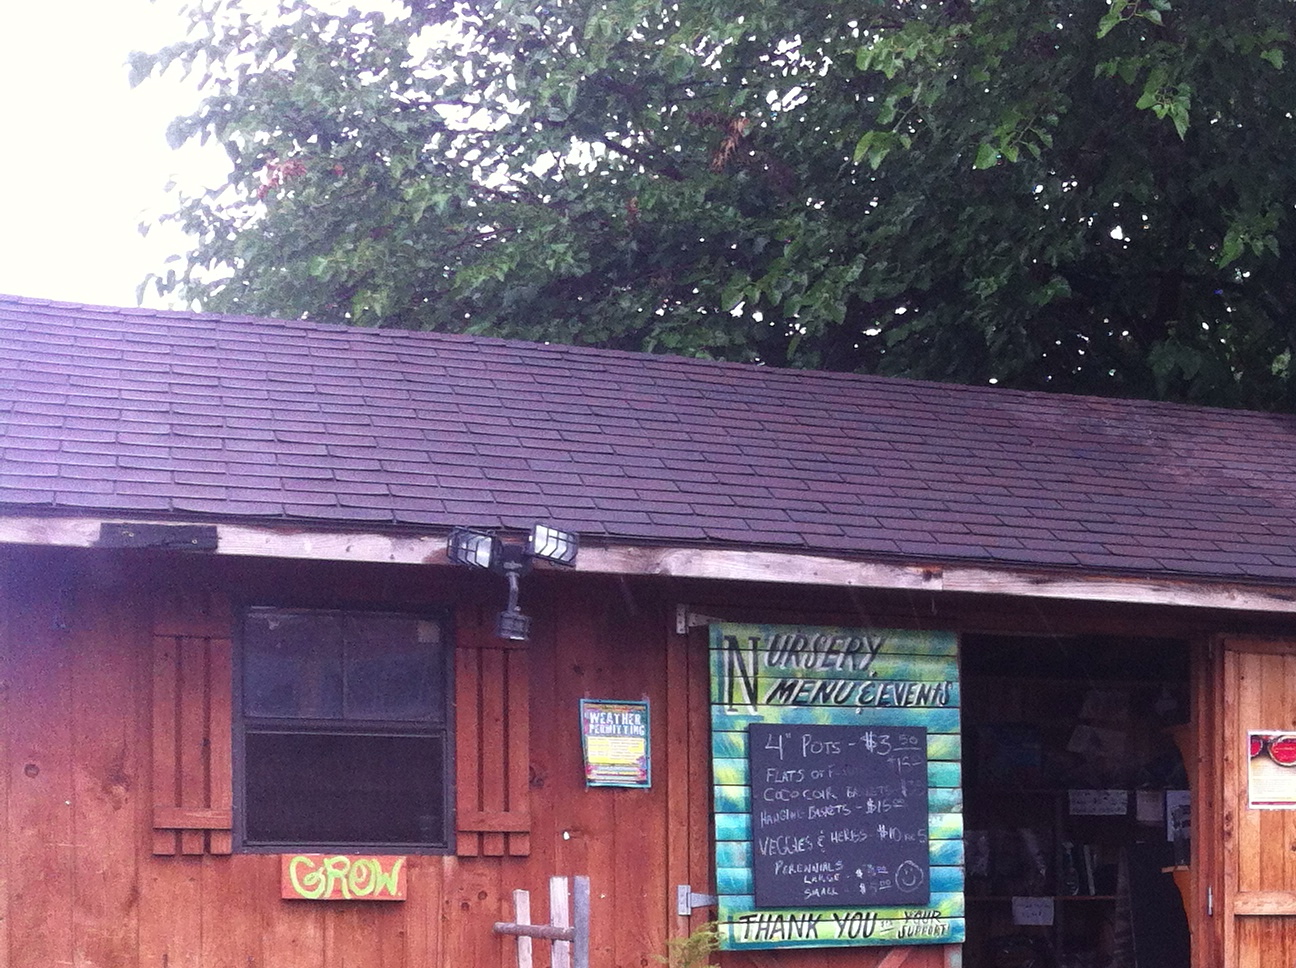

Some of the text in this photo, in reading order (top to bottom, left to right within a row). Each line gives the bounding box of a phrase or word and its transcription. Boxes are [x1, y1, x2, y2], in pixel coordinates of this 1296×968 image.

[723, 632, 884, 716] NURSERY
[764, 679, 854, 705] MENU
[589, 711, 642, 726] WEATHER
[589, 723, 646, 736] PERMITTING
[802, 733, 841, 758] POTS
[766, 767, 806, 783] FLATS
[288, 855, 406, 900] GROW
[774, 860, 843, 876] PERENNIALS
[739, 911, 823, 942] THANK
[831, 911, 878, 940] YOU
